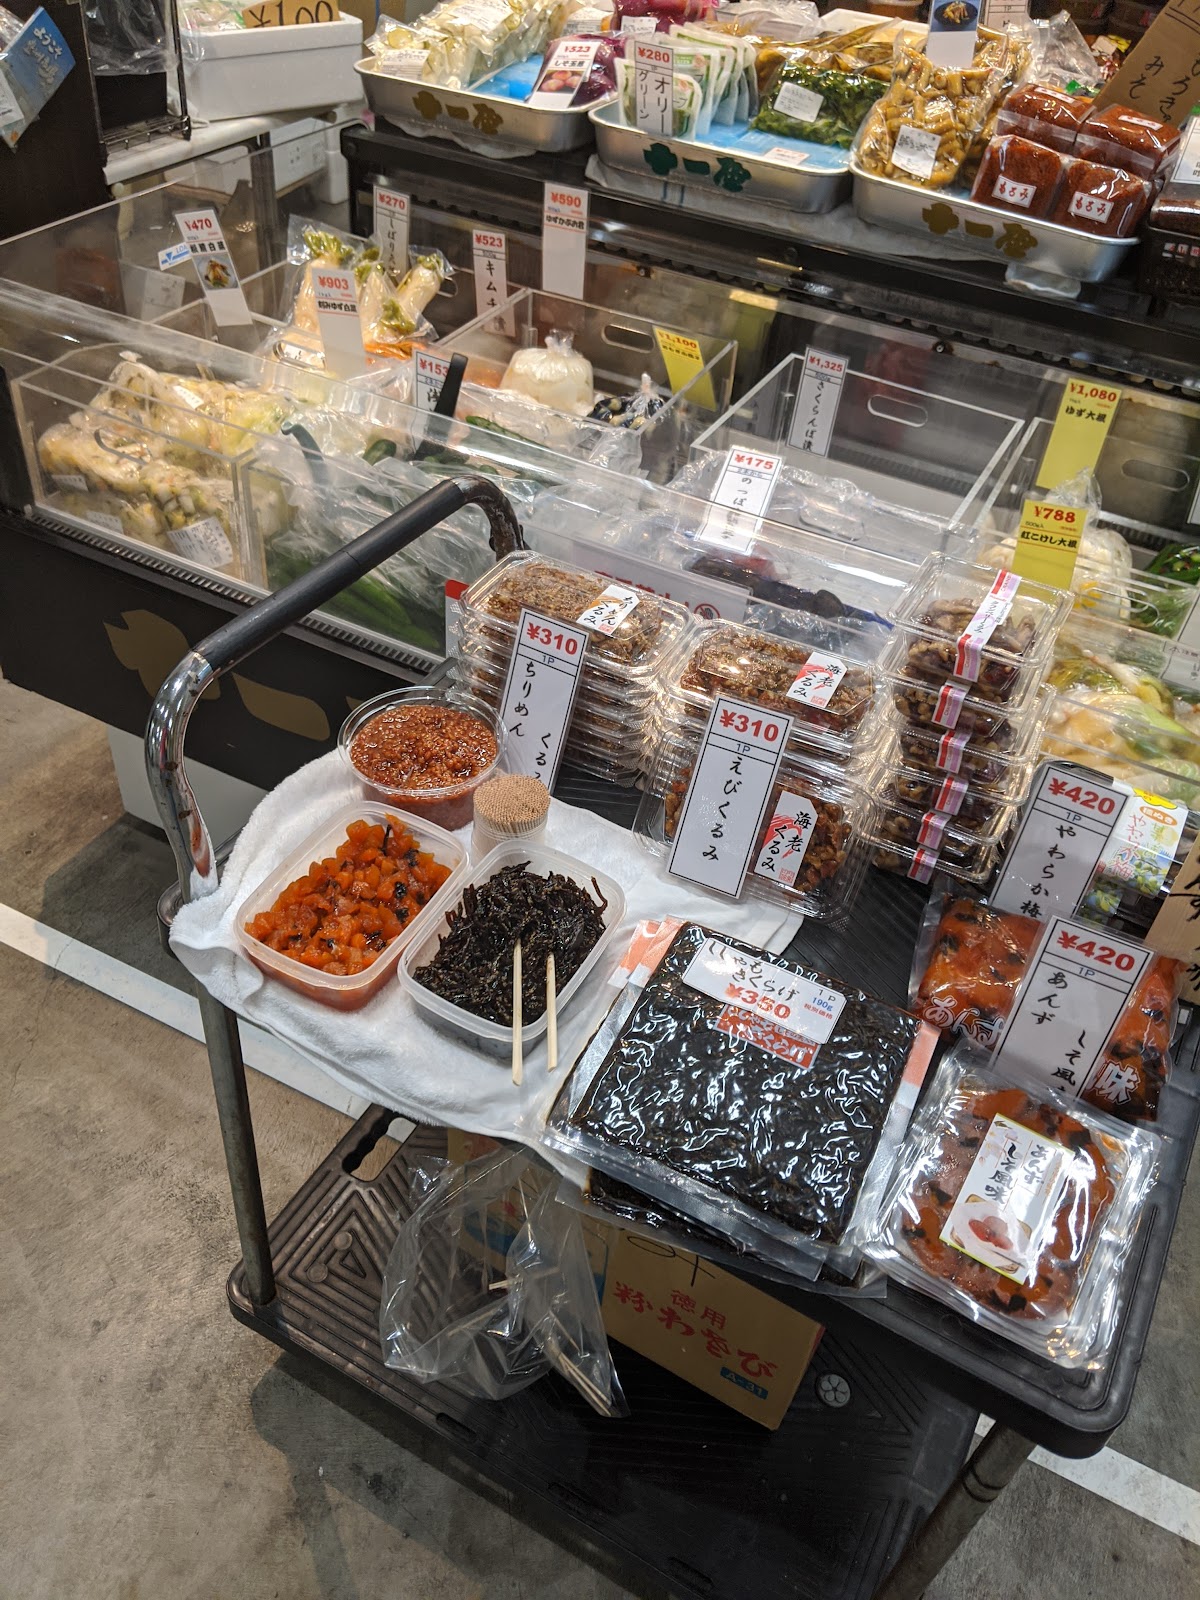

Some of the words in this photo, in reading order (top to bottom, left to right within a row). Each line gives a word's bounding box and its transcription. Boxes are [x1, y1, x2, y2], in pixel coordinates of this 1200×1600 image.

[638, 46, 670, 64] ¥280
[1129, 55, 1165, 99] みそ
[638, 69, 650, 120] グリーン
[378, 193, 406, 211] ¥270
[550, 191, 582, 208] ¥590
[999, 181, 1030, 201] もろみ
[1075, 196, 1107, 216] もろみ
[184, 217, 213, 232] ¥470
[474, 233, 504, 248] ¥523
[317, 275, 349, 290] ¥903
[808, 355, 843, 372] ¥1,325
[1068, 382, 1118, 403] ¥1,080
[1065, 405, 1107, 424] ゆず大根
[734, 453, 774, 470] ¥175
[1033, 505, 1077, 524] ¥788
[526, 621, 579, 656] ¥310
[542, 654, 556, 665] 1P
[793, 669, 819, 698] くるみ
[509, 661, 536, 737] ちりめん
[719, 708, 779, 742] ¥310
[736, 743, 752, 754] 1P
[1048, 777, 1116, 815] ¥420
[702, 756, 743, 862] えびくるみ
[1066, 811, 1082, 822] 1P
[784, 810, 812, 853] 海老
[761, 824, 788, 873] くるみ
[1020, 824, 1077, 919] やわらか梅
[1056, 930, 1136, 972] ¥420
[731, 967, 801, 1002] きくらげ
[1078, 967, 1096, 978] 1P
[724, 982, 791, 1021] ¥350
[812, 996, 834, 1012] 190g
[1030, 971, 1068, 1025] あんず
[1050, 1029, 1086, 1092] しそ風
[670, 1289, 727, 1331] 徳用
[613, 1281, 779, 1379] 粉わさび
[725, 1372, 764, 1397] A-31
